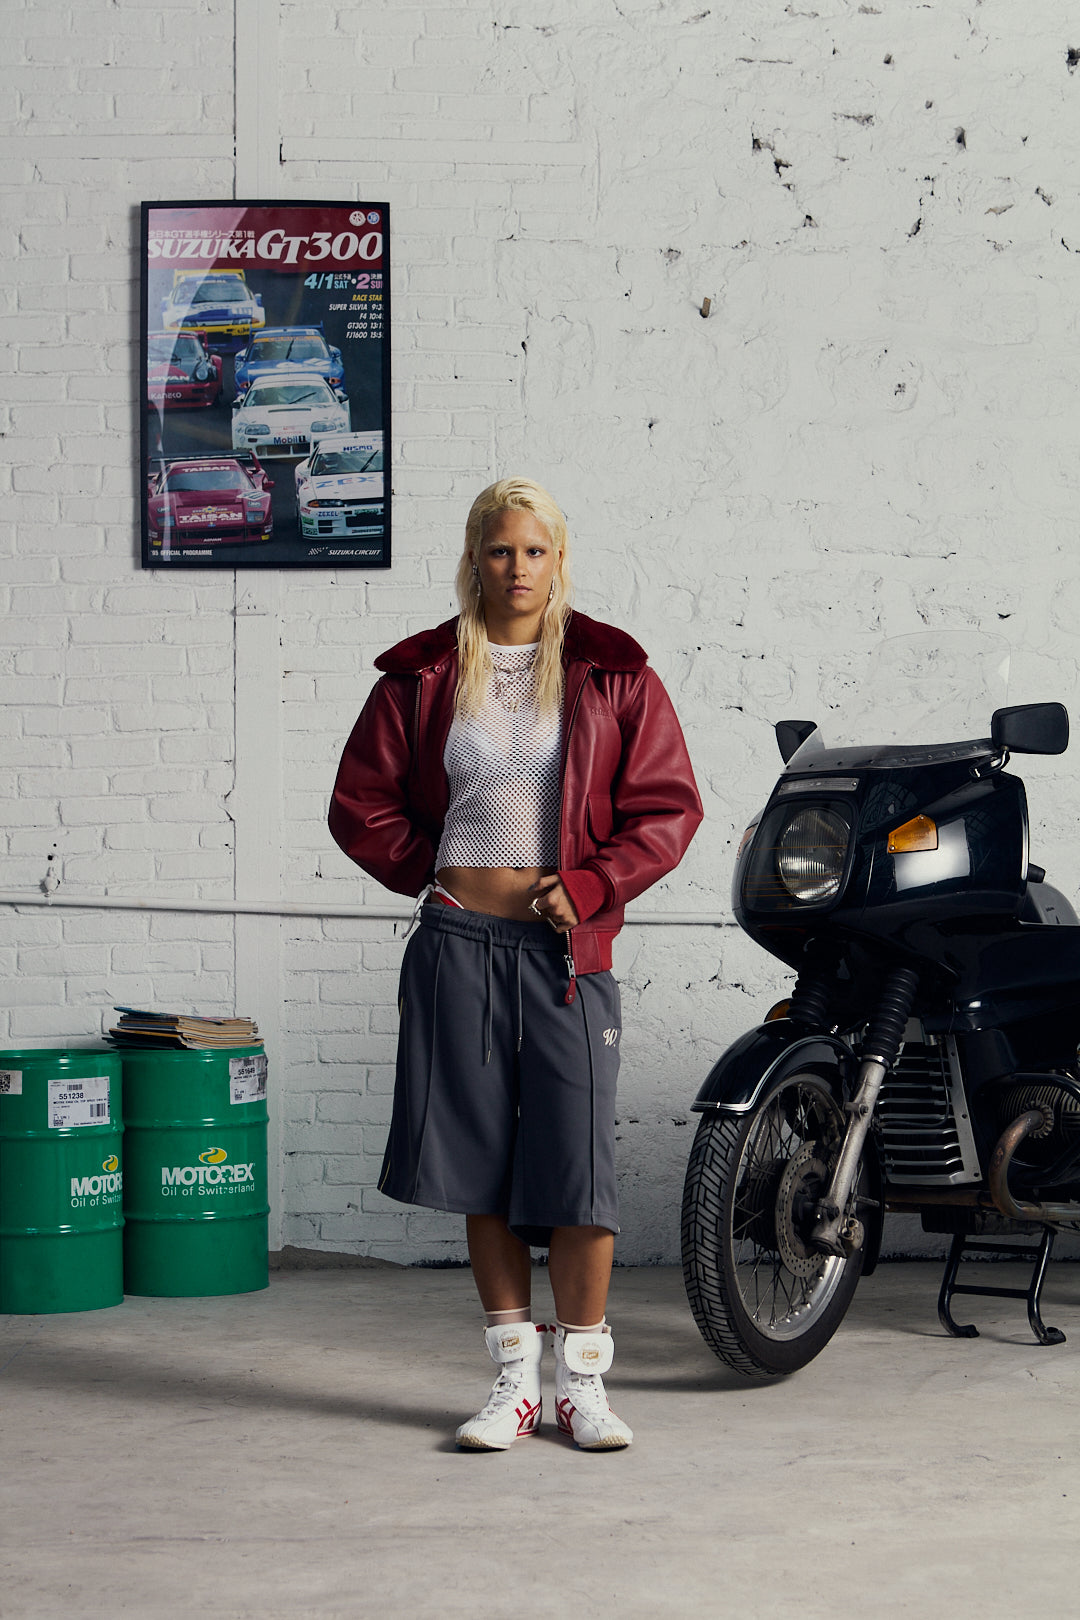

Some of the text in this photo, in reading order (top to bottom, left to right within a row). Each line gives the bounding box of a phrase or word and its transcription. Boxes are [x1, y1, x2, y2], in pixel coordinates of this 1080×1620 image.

[148, 229, 383, 264] SUZUKA GT300
[304, 273, 334, 289] 4/1
[334, 280, 349, 289] SAT
[370, 280, 383, 289] SU
[346, 331, 384, 339] FJ1600 15:5
[273, 436, 298, 444] Mobil
[316, 476, 384, 489] ZEX
[179, 512, 243, 521] TAISAN
[59, 1092, 84, 1100] 551238
[161, 1163, 254, 1186] MOTOREX
[161, 1186, 177, 1196] Oil
[182, 1186, 194, 1196] of
[71, 1197, 86, 1208] Oil
[90, 1195, 99, 1207] of
